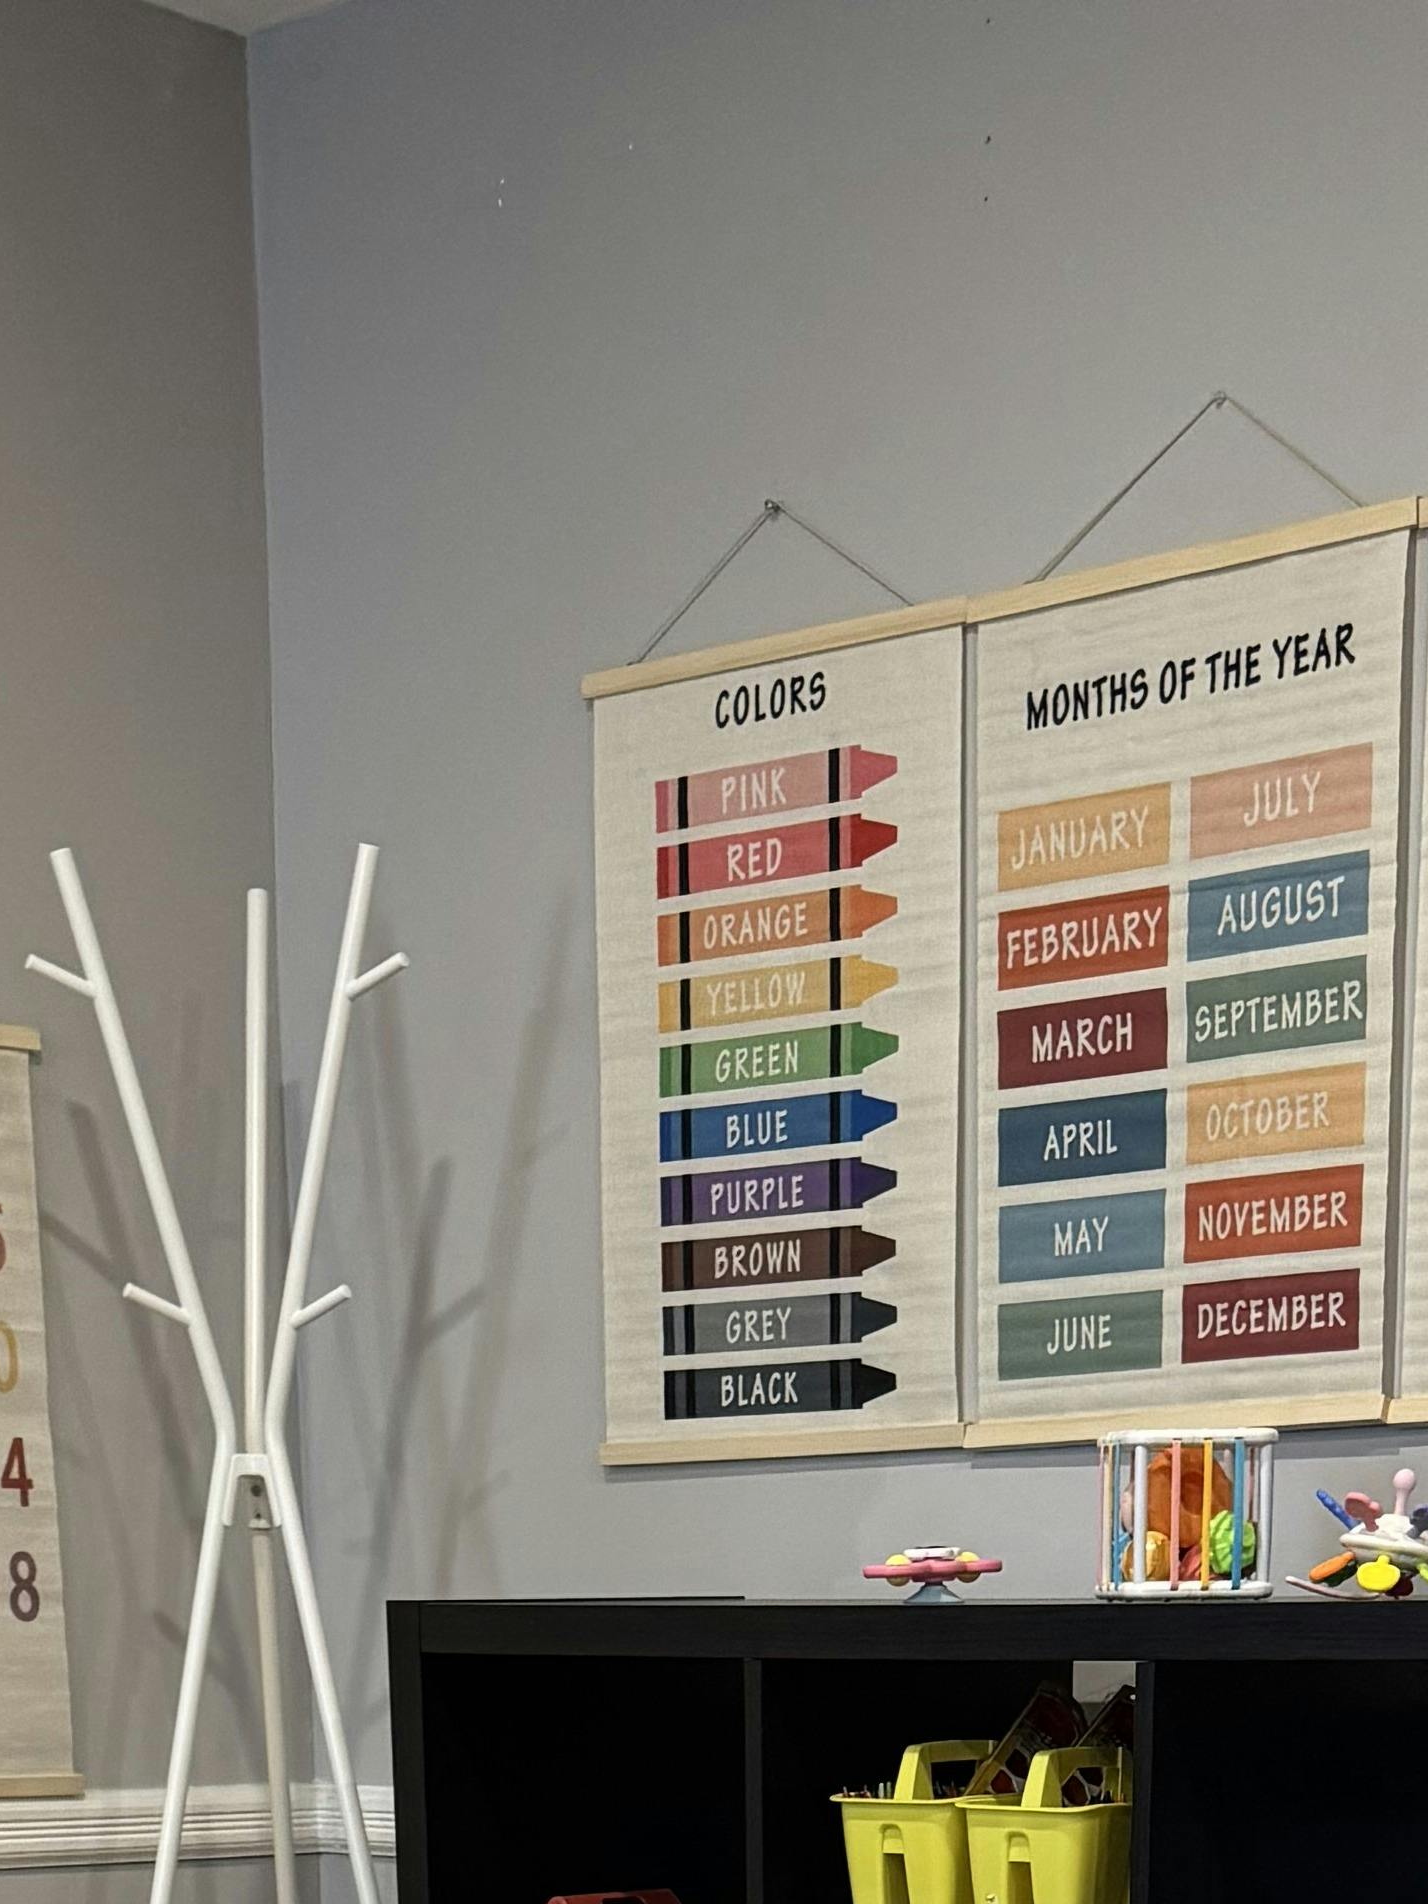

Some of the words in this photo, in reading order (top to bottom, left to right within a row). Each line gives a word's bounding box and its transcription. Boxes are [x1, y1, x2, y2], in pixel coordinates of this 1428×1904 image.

[1027, 668, 1148, 730] MONTHS
[1159, 658, 1196, 704] OF
[1205, 644, 1261, 693] THE
[1273, 623, 1355, 679] YEAR
[716, 672, 825, 728] COLORS
[722, 768, 786, 813] PINK
[1244, 771, 1320, 826] JULY
[728, 838, 781, 881] RED
[1012, 806, 1148, 870] JANUARY
[705, 903, 807, 948] ORANGE
[1218, 876, 1344, 935] AUGUST
[1007, 907, 1162, 968] FEBRUARY
[707, 972, 805, 1019] YELLOW
[1194, 979, 1363, 1042] SEPTEMBER
[1032, 1013, 1132, 1063] MARCH
[716, 1041, 798, 1082] GREEN
[727, 1110, 787, 1147] BLUE
[1207, 1092, 1329, 1140] OCTOBER
[1044, 1120, 1117, 1160] APRIL
[711, 1175, 803, 1215] PURPLE
[1199, 1191, 1347, 1241] NOVEMBER
[715, 1239, 800, 1278] BROWN
[1055, 1216, 1108, 1256] MAY
[726, 1307, 791, 1343] GREY
[1047, 1315, 1111, 1354] JUNE
[1198, 1292, 1346, 1338] DECEMBER
[721, 1372, 797, 1406] BLACK
